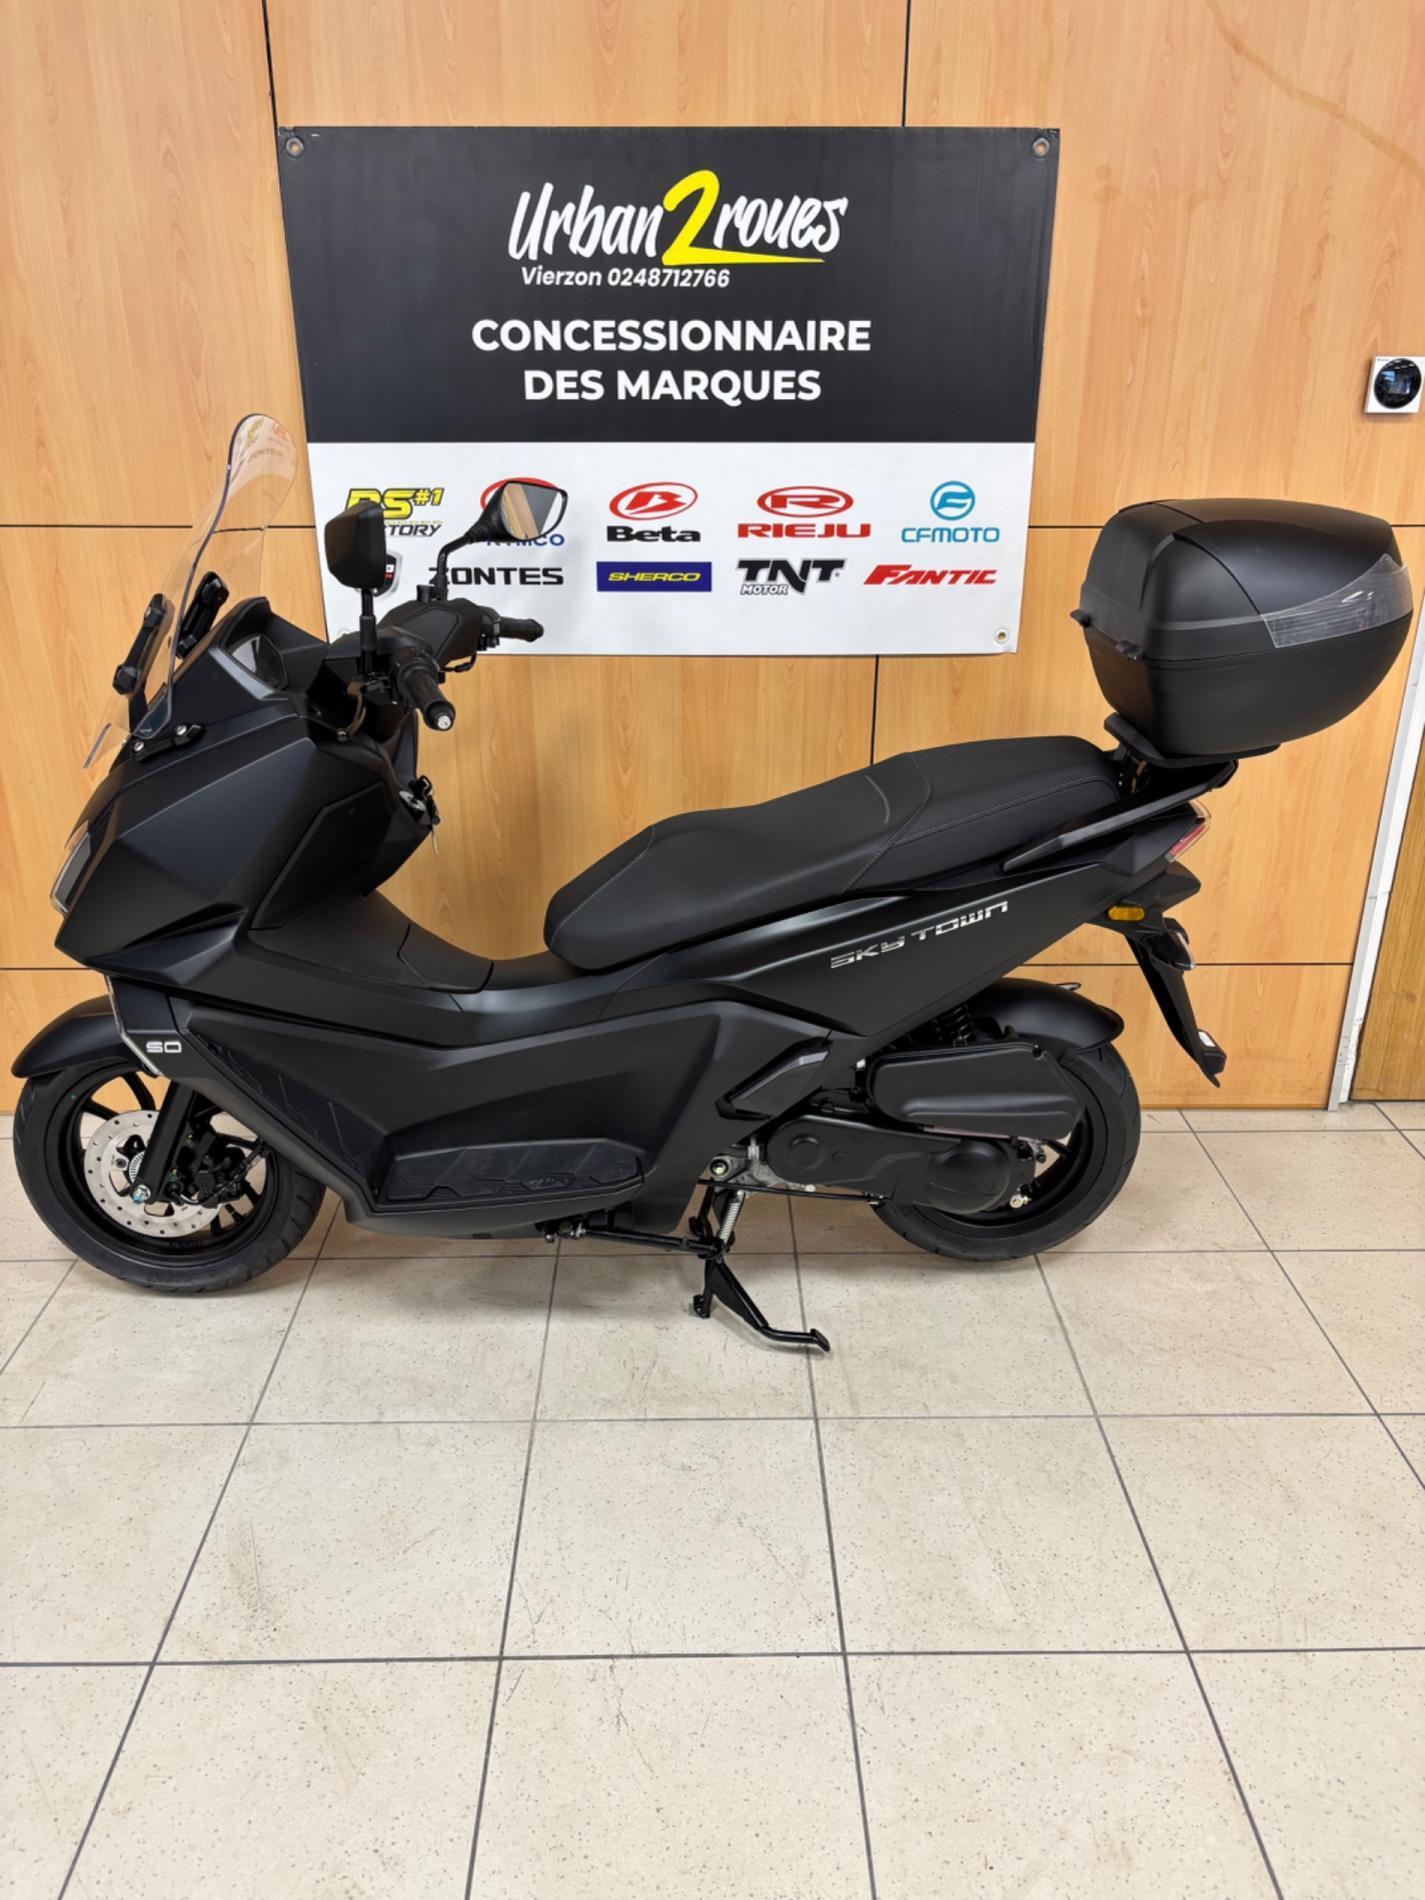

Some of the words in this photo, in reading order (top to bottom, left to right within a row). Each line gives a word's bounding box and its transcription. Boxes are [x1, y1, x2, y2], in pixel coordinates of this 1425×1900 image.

[521, 265, 602, 287] Vierzon
[606, 266, 731, 288] 0248712766
[471, 319, 872, 352] CONCESSIONNAIRE
[523, 369, 605, 401] DES
[616, 369, 822, 407] MARQUES
[606, 525, 702, 543] Beta
[737, 523, 872, 539] RIEJU
[900, 526, 1001, 543] CFMOTO
[607, 572, 701, 582] SHERCO
[736, 557, 847, 595] TNT
[863, 564, 998, 586] FANTIC
[740, 583, 789, 596] MOTOR
